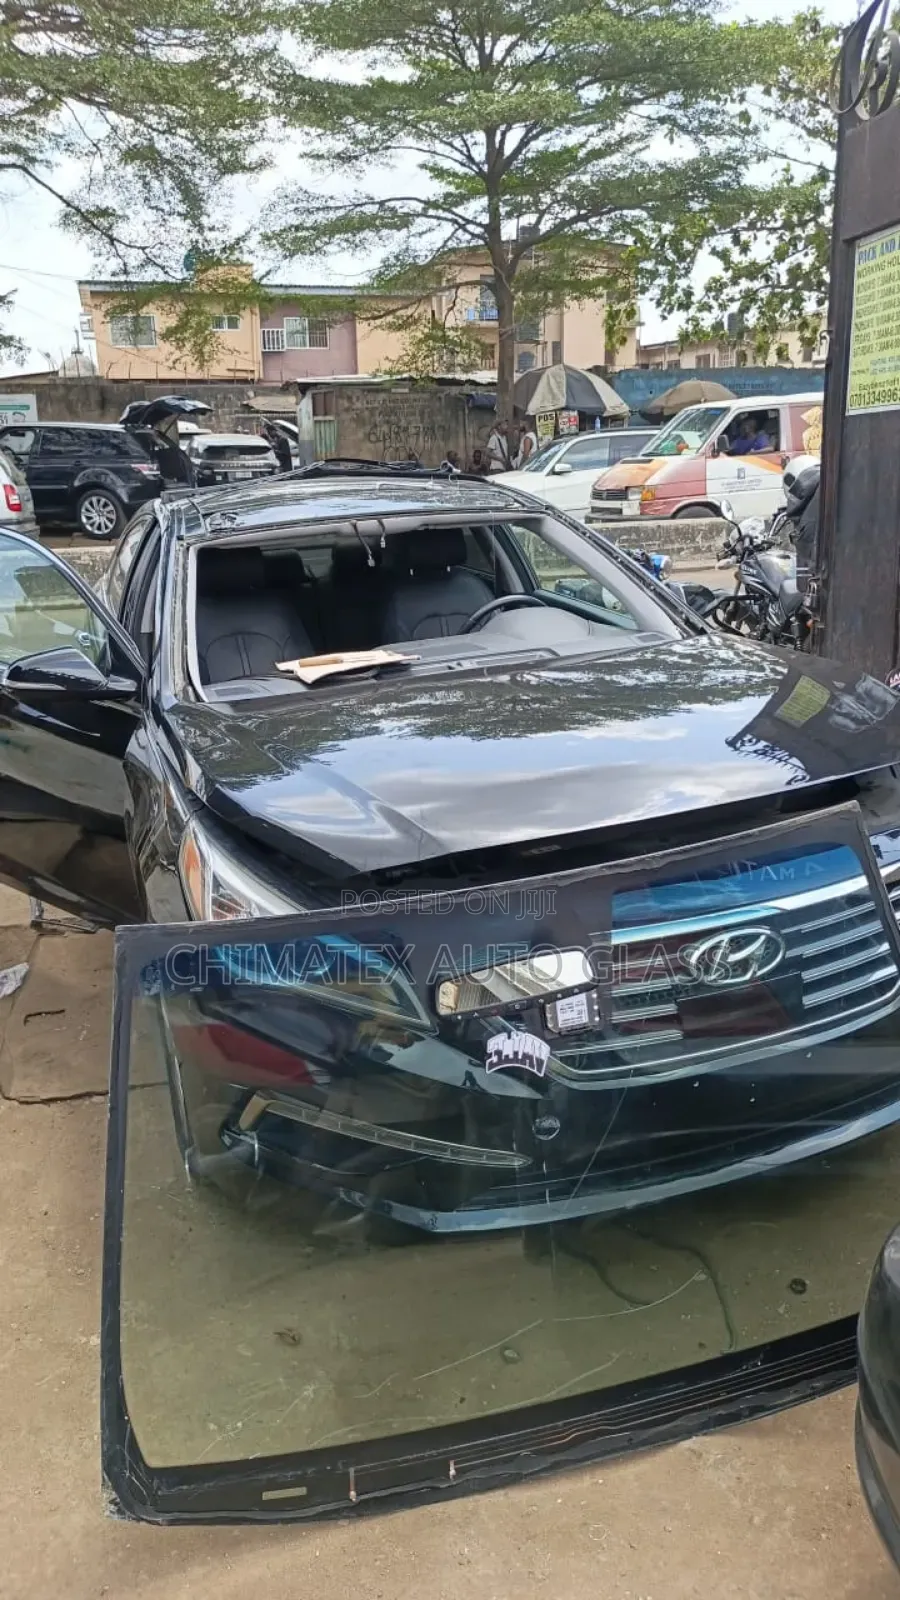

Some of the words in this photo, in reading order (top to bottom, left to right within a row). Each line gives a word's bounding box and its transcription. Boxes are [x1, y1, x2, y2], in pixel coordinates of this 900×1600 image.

[858, 246, 876, 265] PICK
[850, 387, 900, 407] 0701334996
[538, 413, 555, 423] POS
